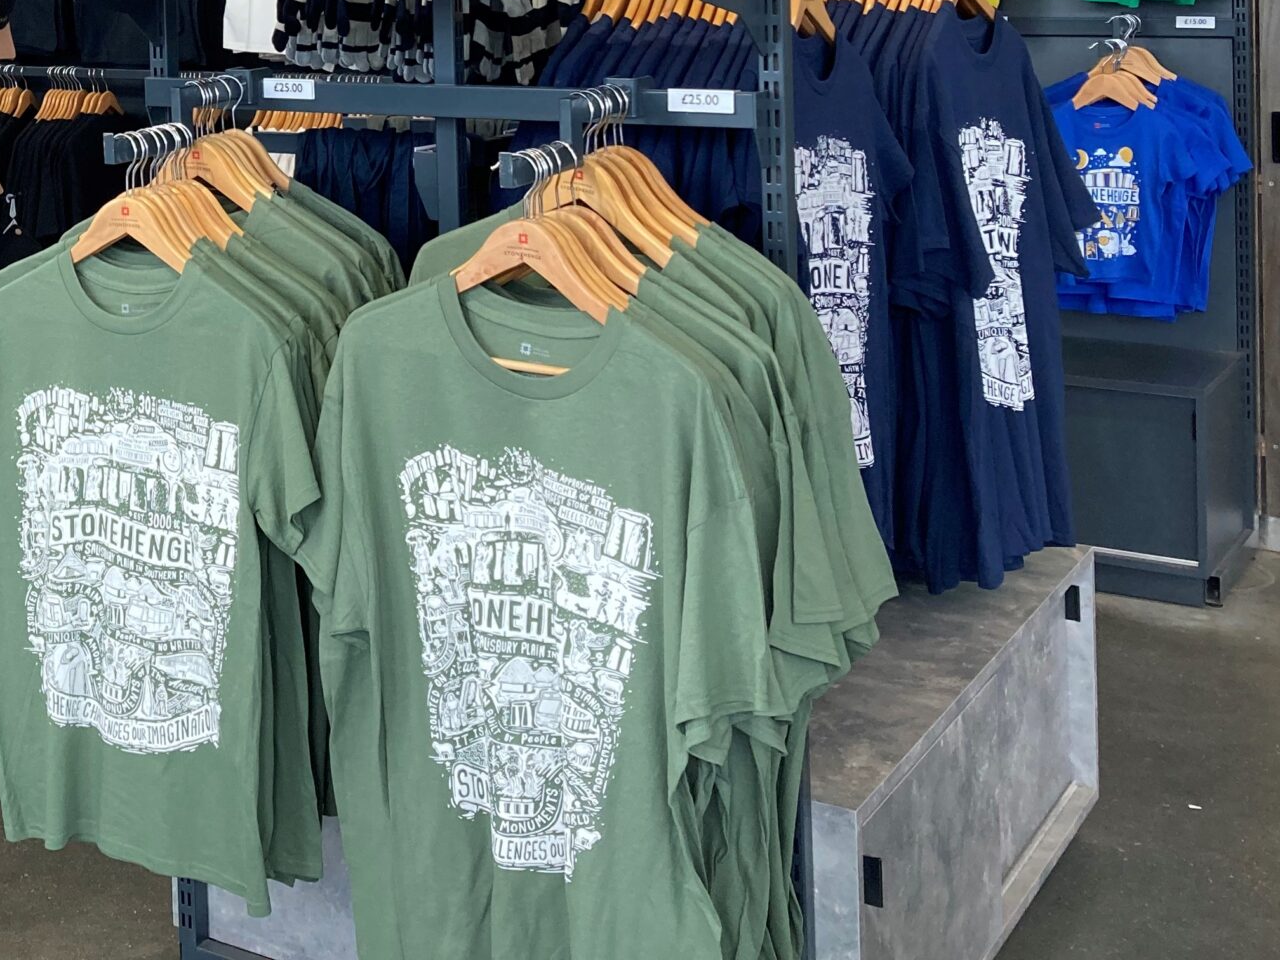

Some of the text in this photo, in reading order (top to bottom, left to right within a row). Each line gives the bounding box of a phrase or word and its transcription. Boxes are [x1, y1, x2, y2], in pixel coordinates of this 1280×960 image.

[273, 82, 303, 94] £25.00
[682, 93, 720, 108] £25.00
[147, 512, 172, 529] 3000
[52, 512, 193, 565] STONEHENGE
[144, 566, 177, 580] SOUTHERN
[27, 591, 39, 633] ISOLATED
[158, 643, 168, 652] NO
[521, 643, 545, 658] PLAIN
[434, 674, 447, 688] ON
[574, 686, 604, 717] STANDS
[430, 689, 441, 740] ISOLATED
[485, 708, 501, 735] BUILT
[131, 726, 146, 740] OUR
[454, 725, 485, 748] IT IS
[500, 788, 558, 832] MONUMENTS
